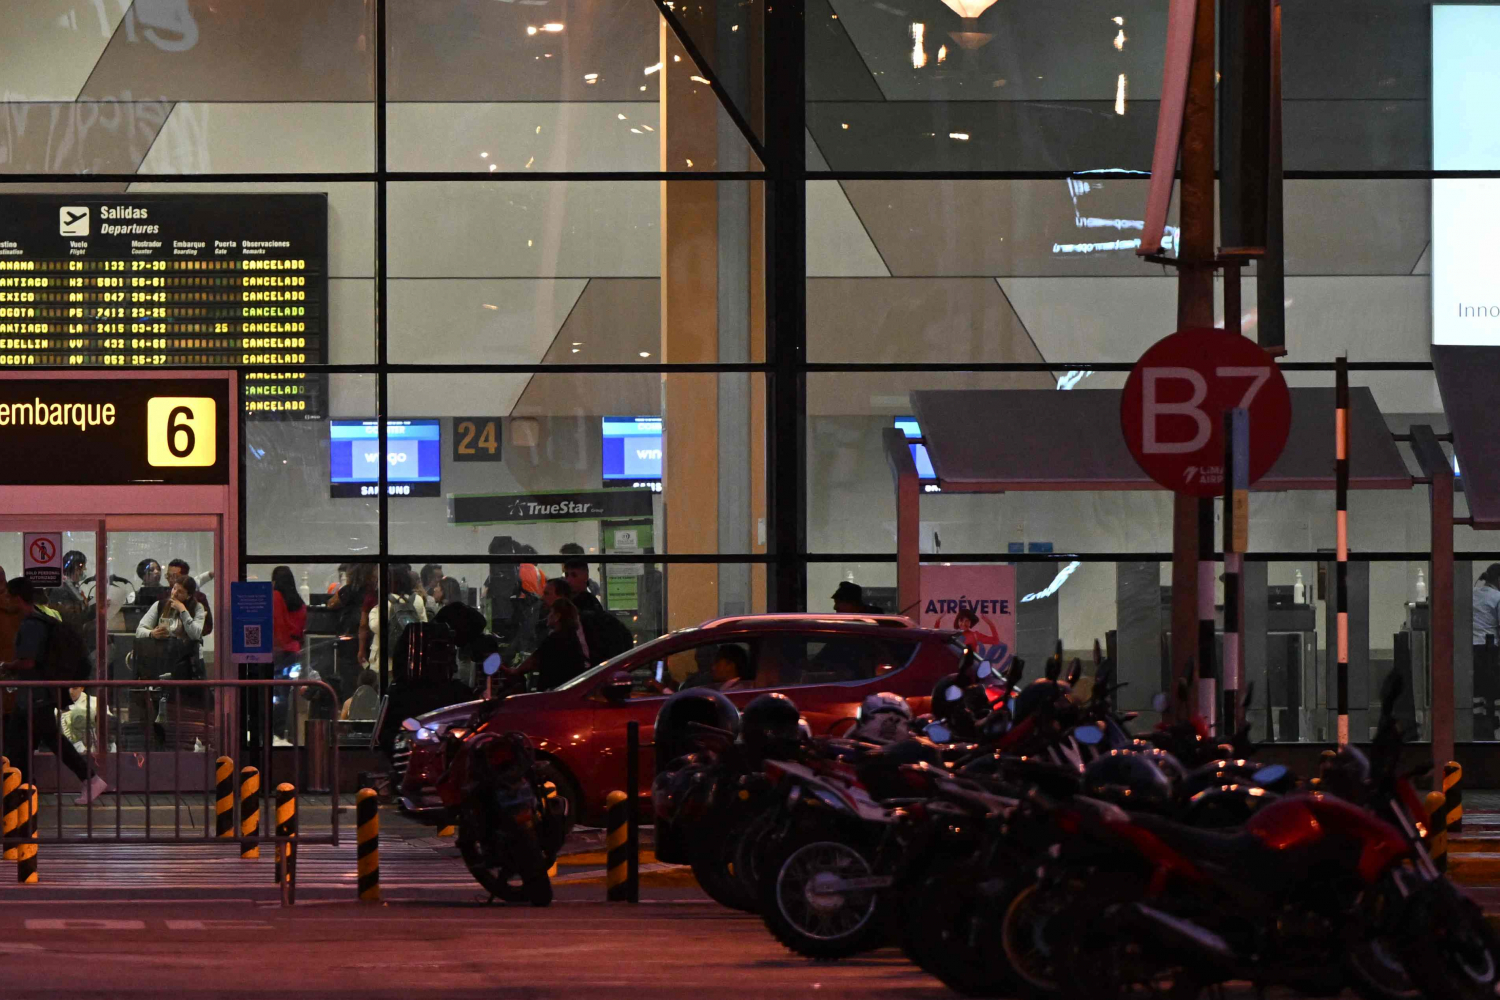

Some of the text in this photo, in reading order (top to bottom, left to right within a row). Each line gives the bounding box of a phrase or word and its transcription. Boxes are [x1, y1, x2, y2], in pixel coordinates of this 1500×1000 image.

[100, 206, 148, 220] Salidas
[100, 222, 160, 236] Departures
[70, 240, 88, 248] Vuelo
[131, 240, 162, 248] Mostrador
[173, 240, 206, 250] Embarque
[214, 240, 237, 248] Puerta
[242, 240, 290, 248] Observaciones
[104, 261, 124, 270] 132
[242, 260, 306, 270] CANCELADO
[242, 276, 306, 286] CANCELADO
[104, 292, 124, 302] 047
[242, 291, 306, 300] CANCELADO
[97, 308, 124, 318] 7412
[242, 308, 306, 316] CANCELADO
[97, 324, 124, 333] 2415
[214, 323, 228, 332] 25
[242, 322, 306, 332] CANCELADO
[104, 339, 124, 348] 432
[242, 338, 306, 348] CANCELADO
[104, 355, 124, 364] 052
[242, 354, 306, 364] CANCELADO
[1142, 366, 1271, 454] B7
[166, 405, 196, 458] 6
[458, 421, 498, 454] 24
[527, 500, 591, 516] TrueStar
